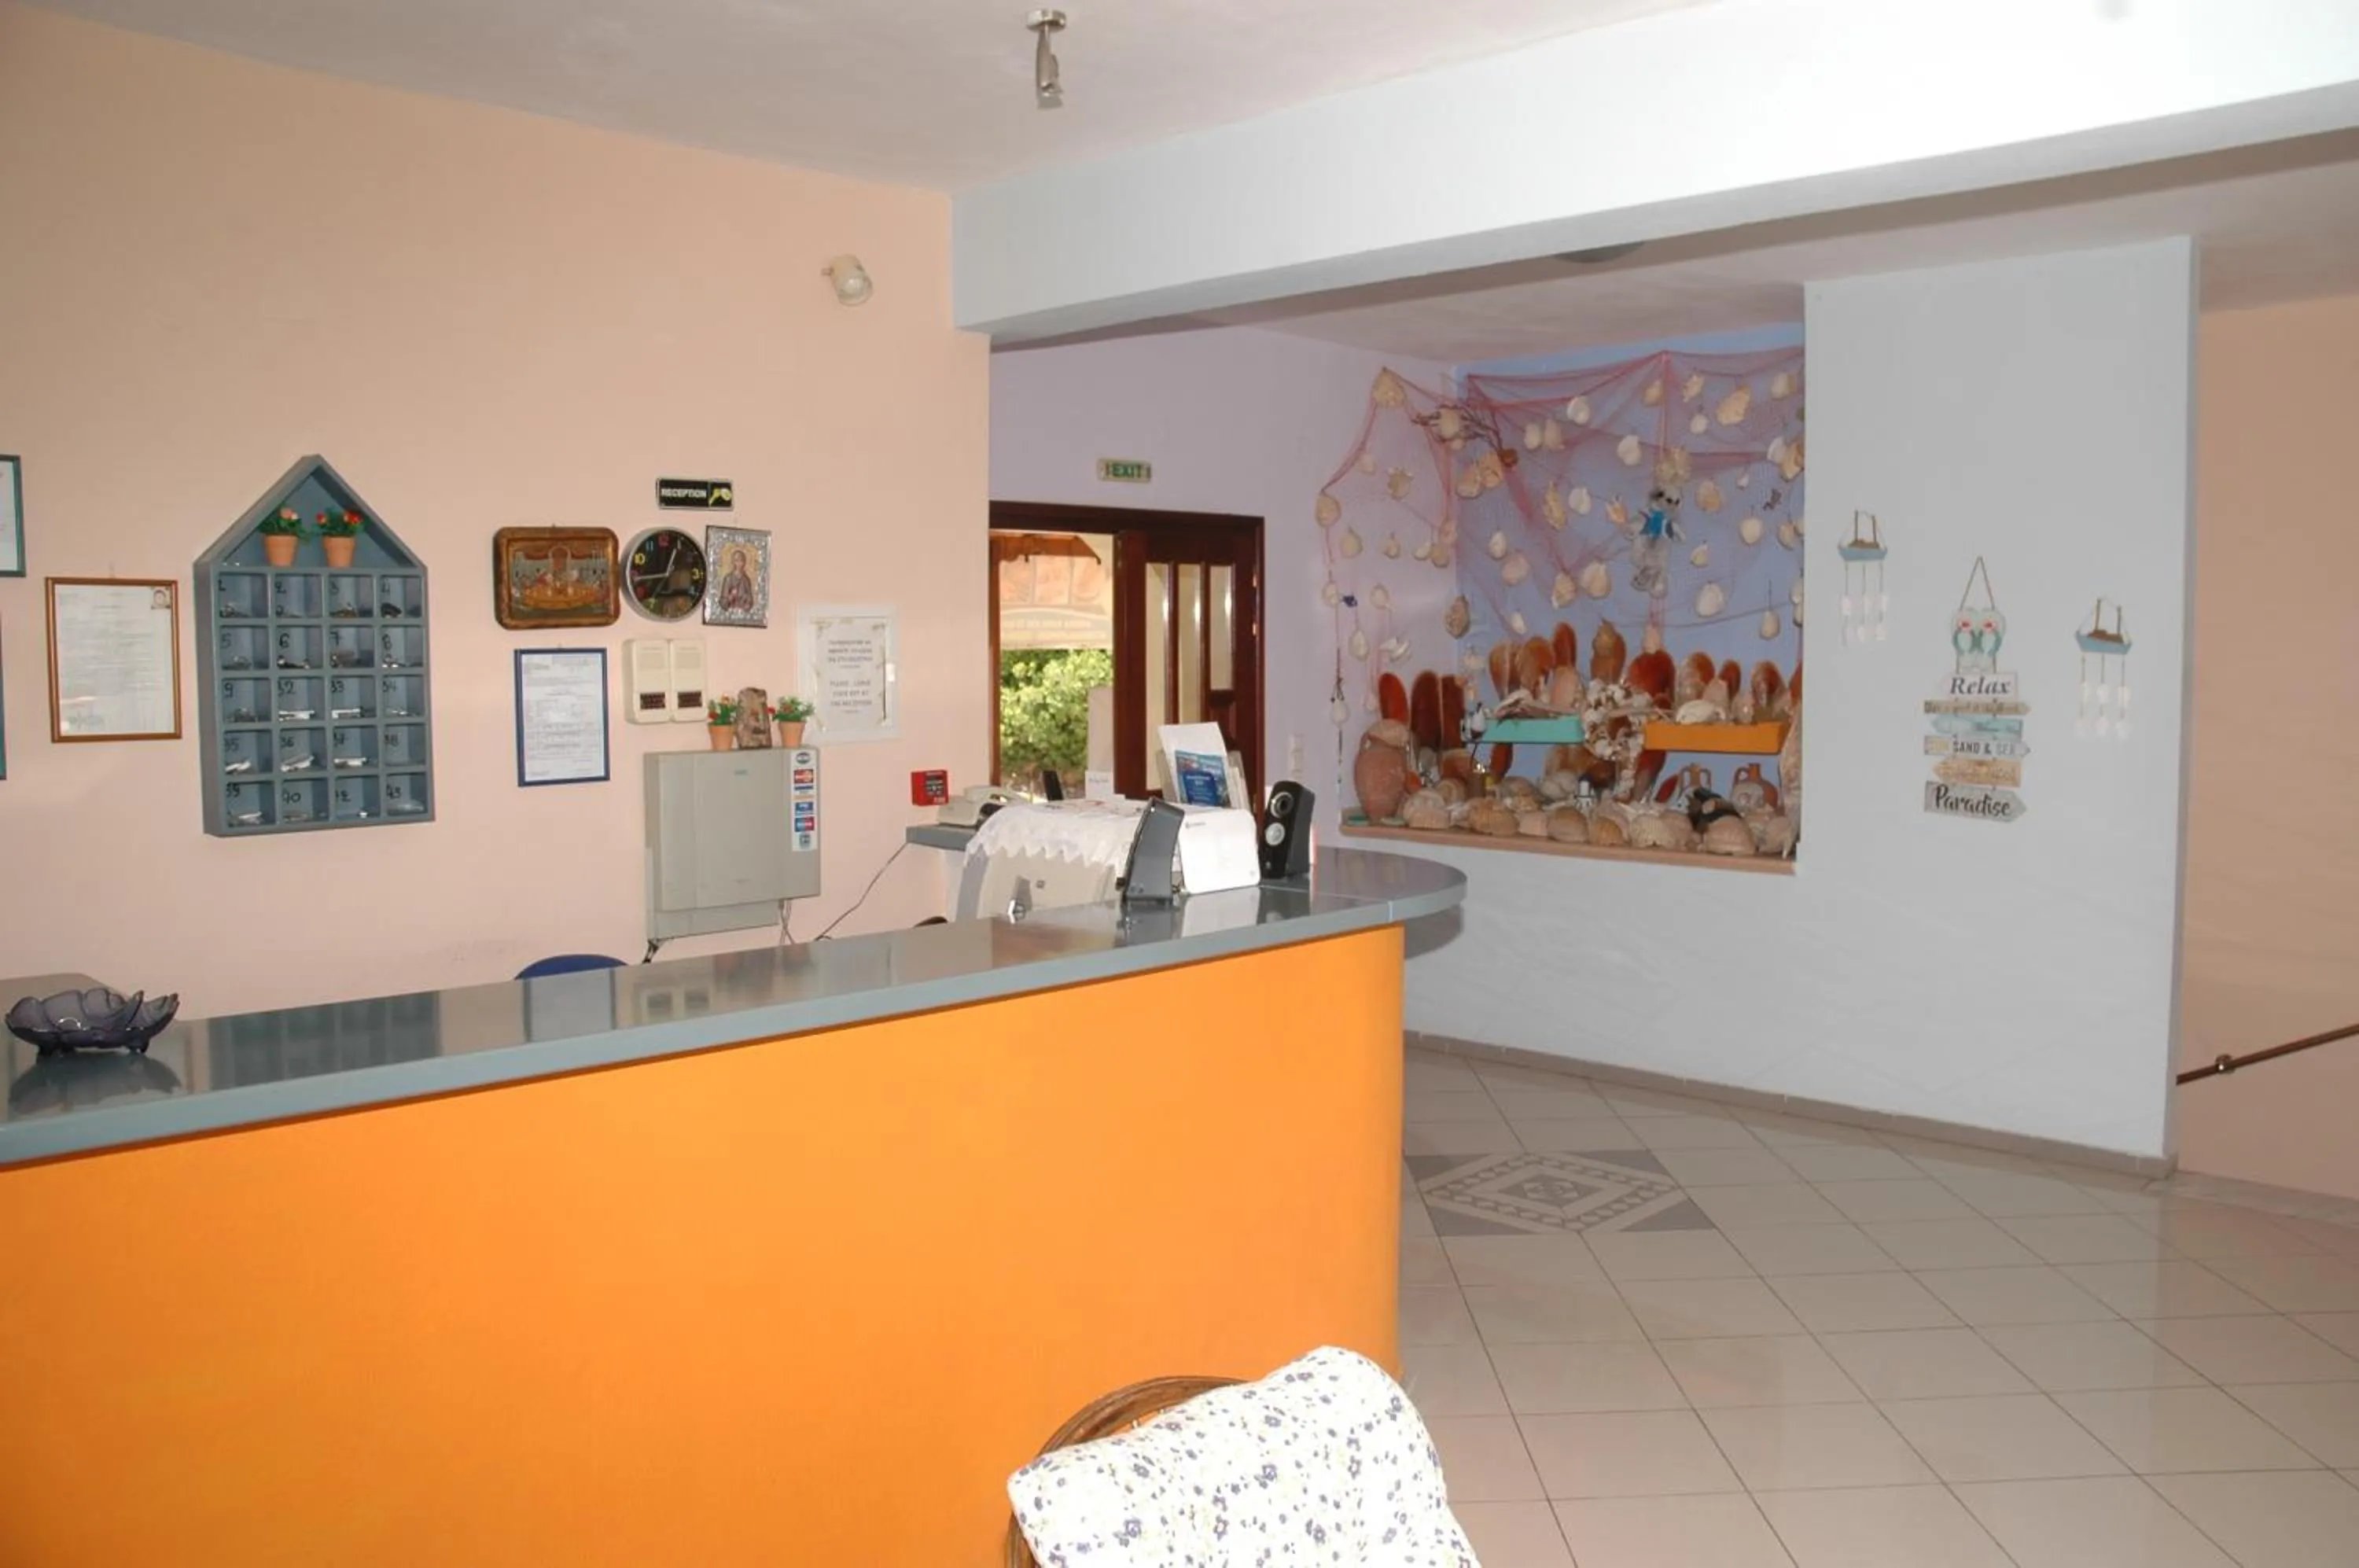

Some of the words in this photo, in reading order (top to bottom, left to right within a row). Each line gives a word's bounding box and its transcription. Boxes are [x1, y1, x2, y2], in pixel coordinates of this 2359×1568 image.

[1112, 462, 1143, 479] EXIT
[661, 488, 706, 498] RECEPTION
[646, 540, 654, 551] 11
[635, 553, 645, 565] 10
[692, 568, 699, 580] 3
[275, 581, 286, 594] 2
[222, 633, 231, 649] 5
[279, 633, 289, 649] 6
[329, 631, 341, 646] 7
[381, 634, 392, 650] 8
[224, 683, 234, 698] 9
[1950, 675, 2011, 695] Relax
[280, 736, 295, 748] 36
[1953, 741, 1981, 754] SAND
[1984, 742, 1992, 754] &
[1935, 783, 2011, 817] Paradise
